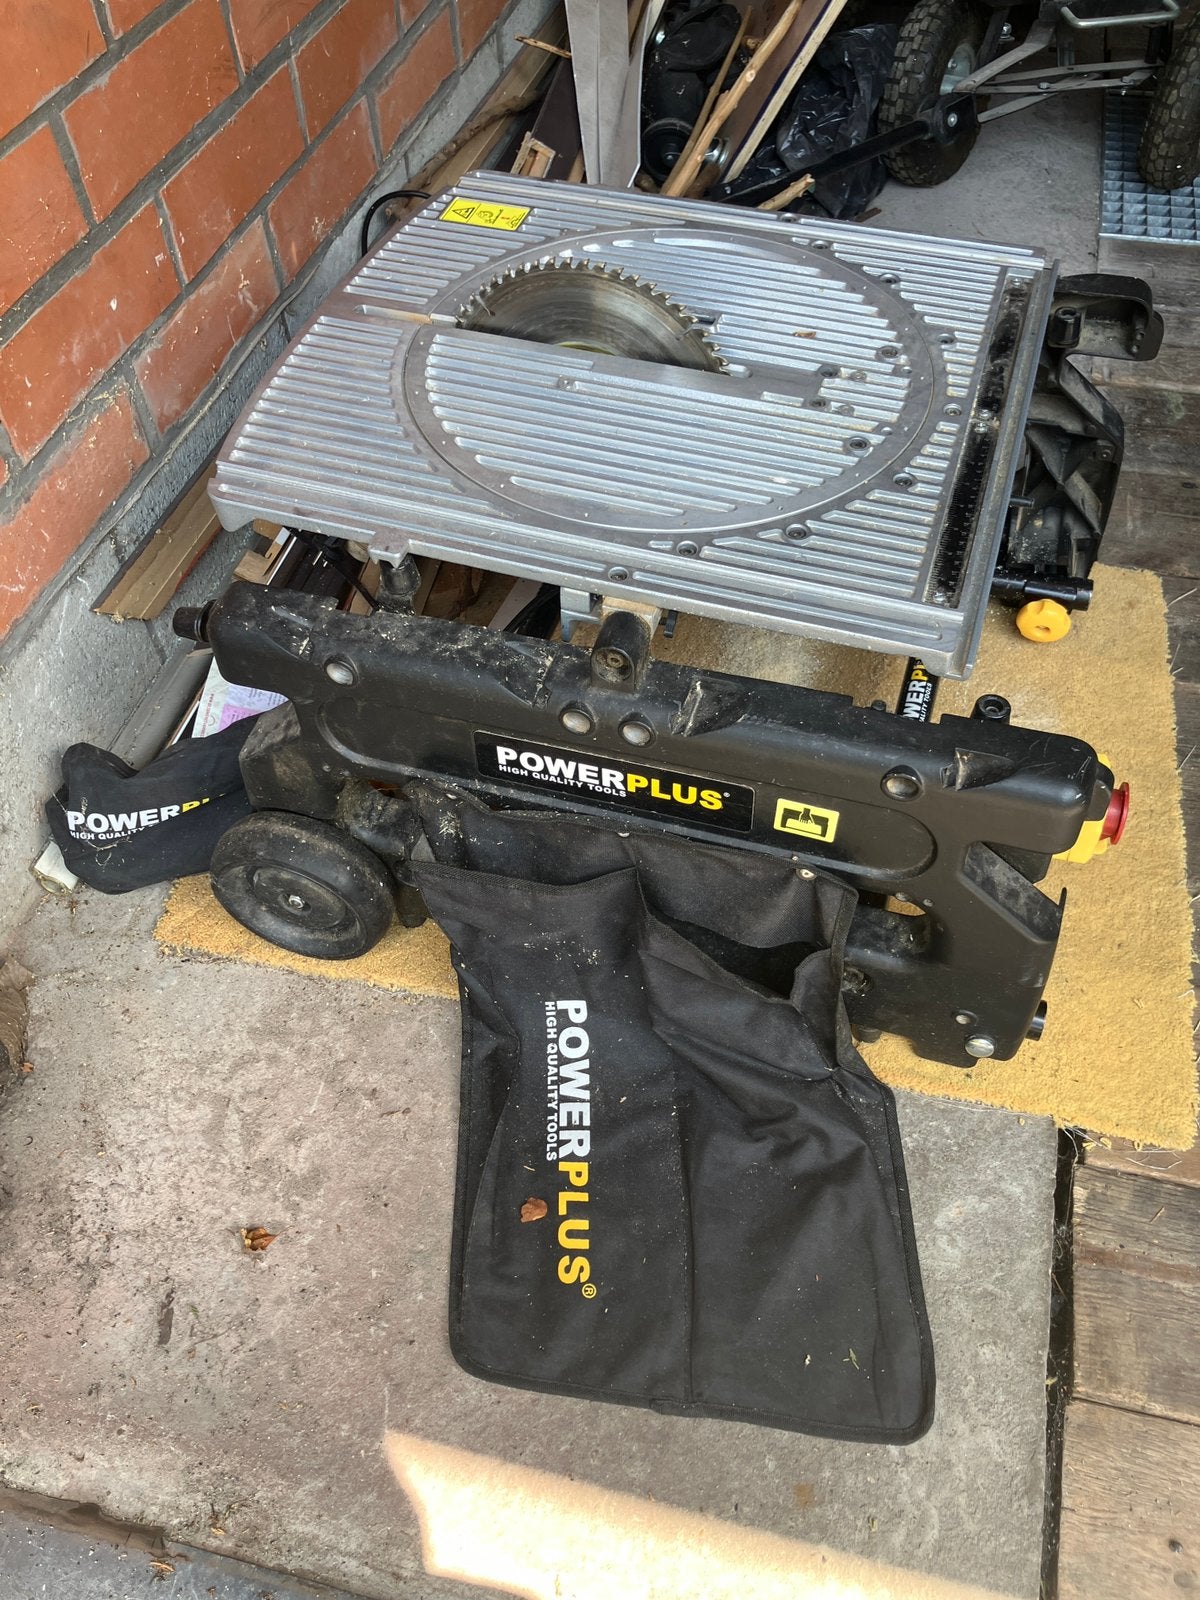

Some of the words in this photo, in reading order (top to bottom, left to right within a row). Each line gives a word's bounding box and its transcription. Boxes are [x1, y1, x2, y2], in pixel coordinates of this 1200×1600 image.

[499, 764, 529, 777] HIGH
[532, 771, 584, 788] QUALITY
[587, 783, 627, 797] TOOLS
[70, 830, 95, 840] HIGH
[98, 826, 146, 840] QUALITY
[545, 1001, 557, 1039] HIGH
[546, 1042, 558, 1108] QUALITY
[546, 1112, 558, 1161] TOOLS
